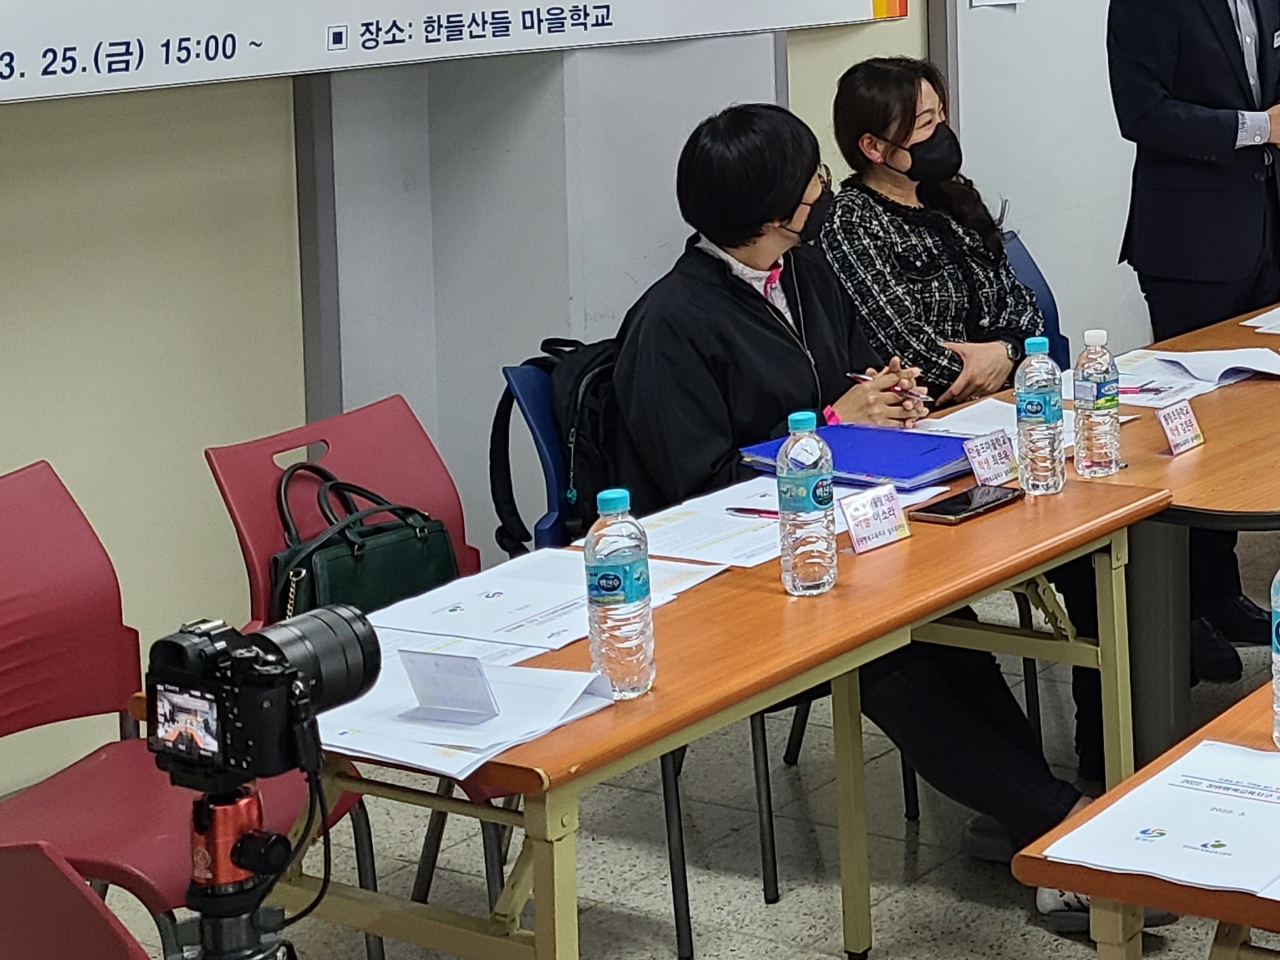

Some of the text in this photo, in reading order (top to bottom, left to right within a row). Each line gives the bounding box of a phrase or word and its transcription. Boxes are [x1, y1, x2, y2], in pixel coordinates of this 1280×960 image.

[359, 3, 613, 50] 장소: 한들산들 마을학교
[41, 38, 144, 77] 25.(금)
[160, 33, 237, 65] 15:00
[872, 506, 897, 524] 이소라
